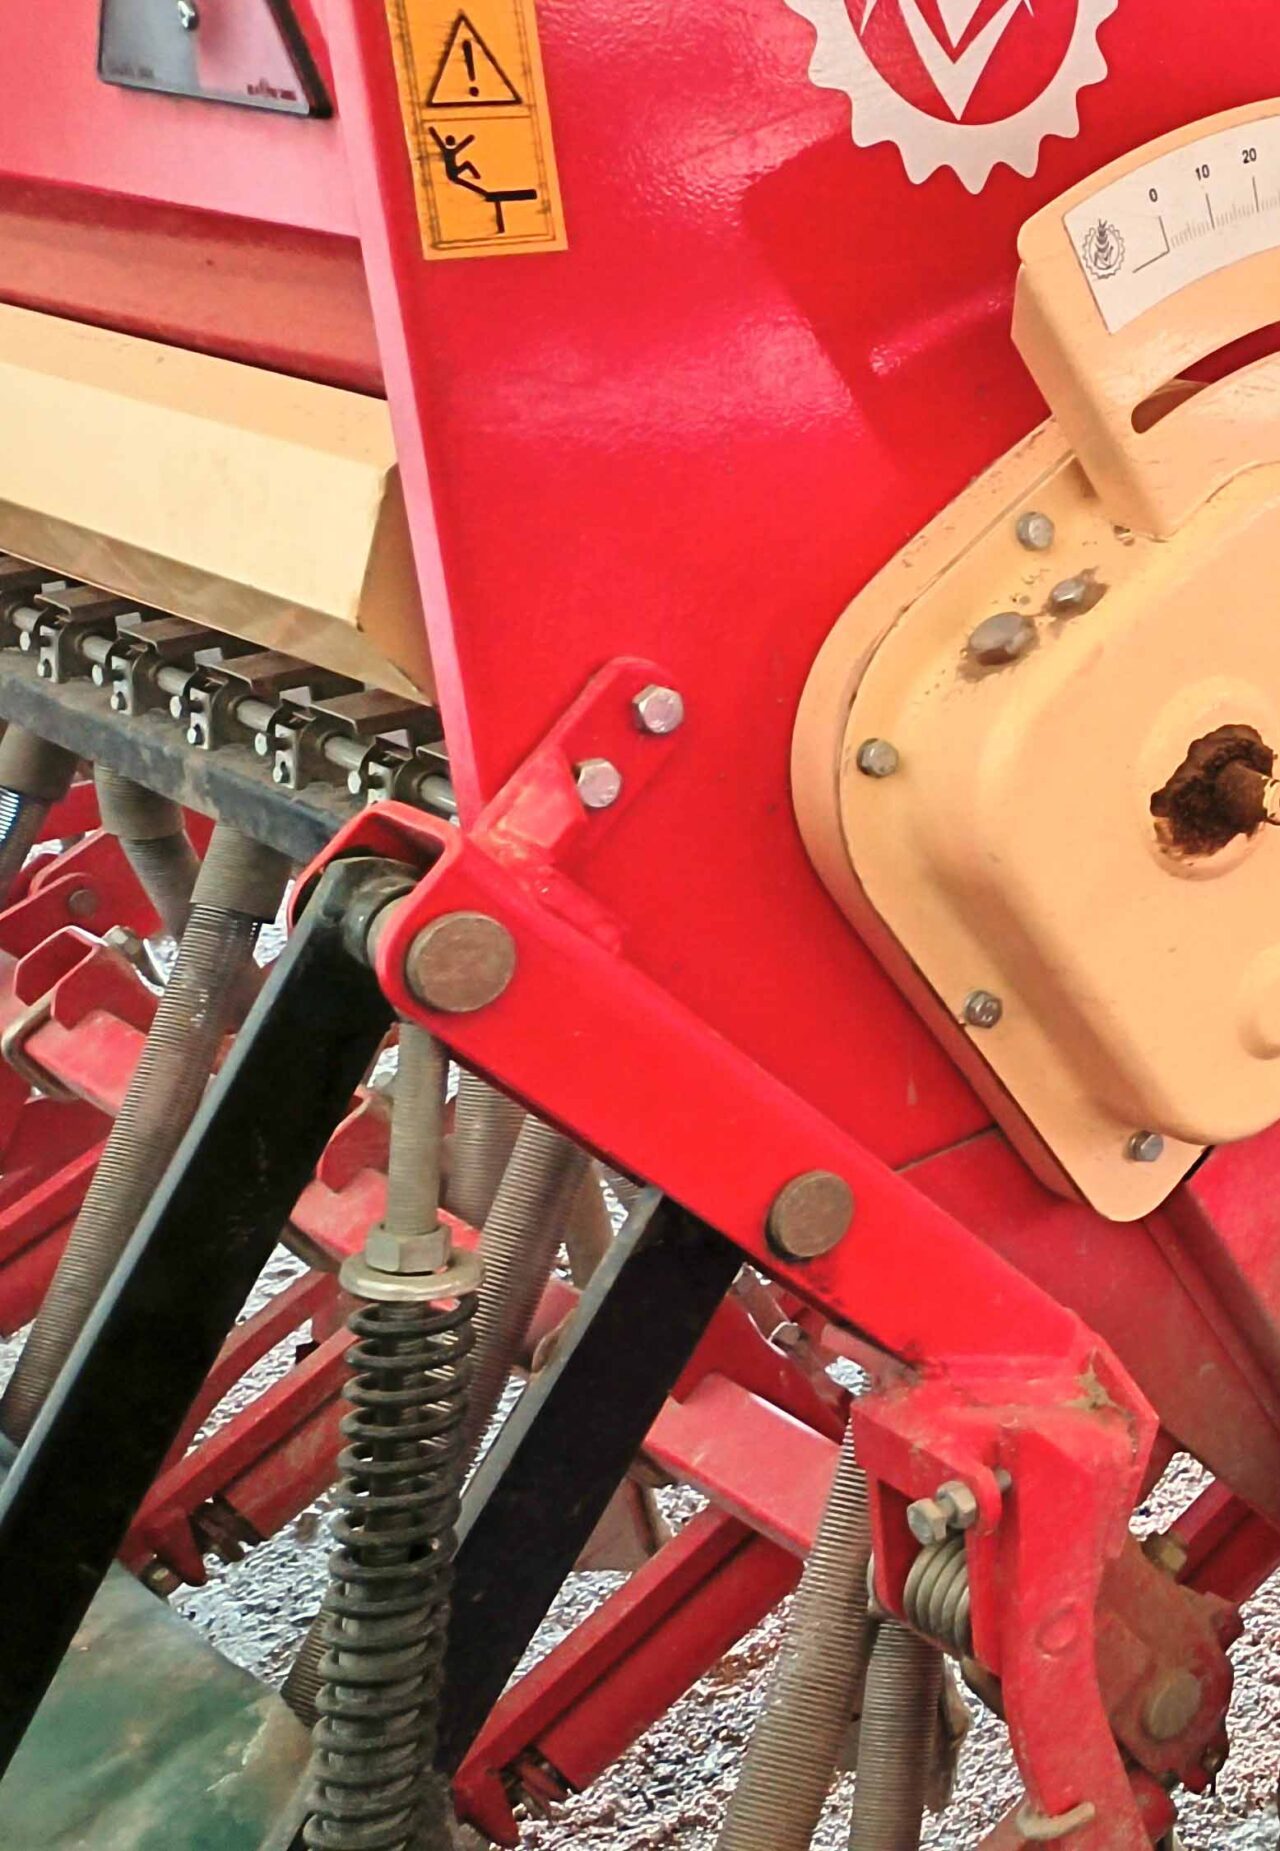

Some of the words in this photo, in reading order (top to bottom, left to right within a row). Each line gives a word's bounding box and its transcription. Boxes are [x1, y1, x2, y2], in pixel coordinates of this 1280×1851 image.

[1148, 187, 1158, 202] 0
[1195, 164, 1210, 181] 10
[1242, 147, 1257, 164] 20
